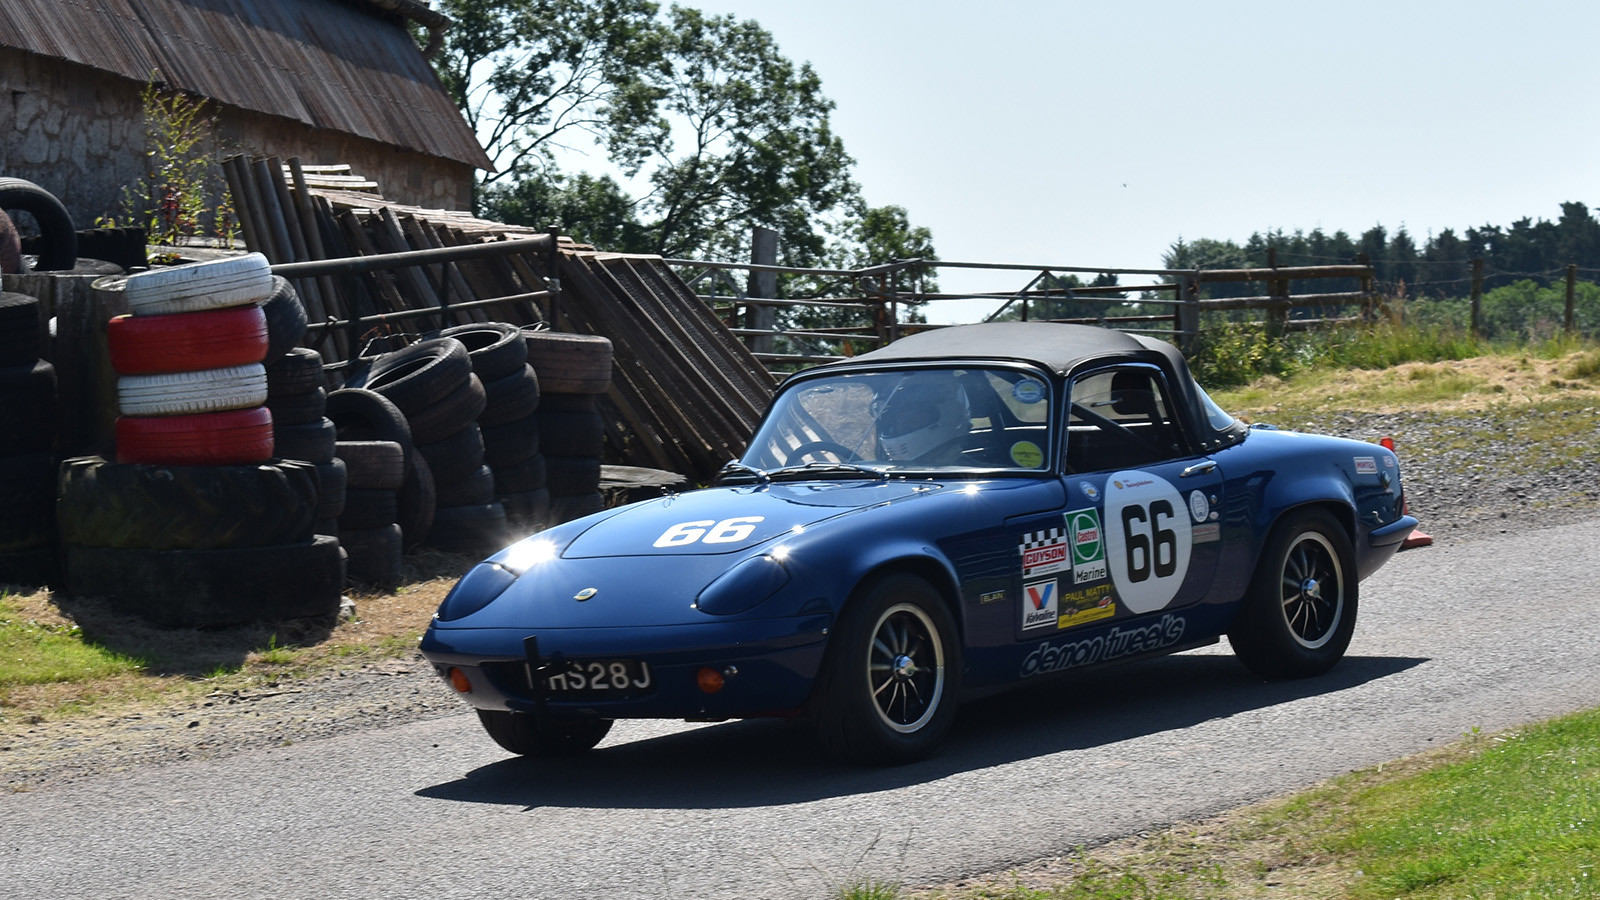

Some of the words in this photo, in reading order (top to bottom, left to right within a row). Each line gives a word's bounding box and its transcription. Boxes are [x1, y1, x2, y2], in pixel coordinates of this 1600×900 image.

[652, 516, 765, 548] 66
[1076, 528, 1099, 543] Castrol
[1121, 499, 1177, 584] 66
[1026, 547, 1065, 564] GUYSON
[1075, 567, 1106, 583] Marine
[1065, 590, 1085, 602] PAUL
[1085, 583, 1111, 597] MATTY
[1026, 608, 1056, 625] Valvoline
[1020, 639, 1104, 678] demon
[1102, 614, 1186, 660] tweeks
